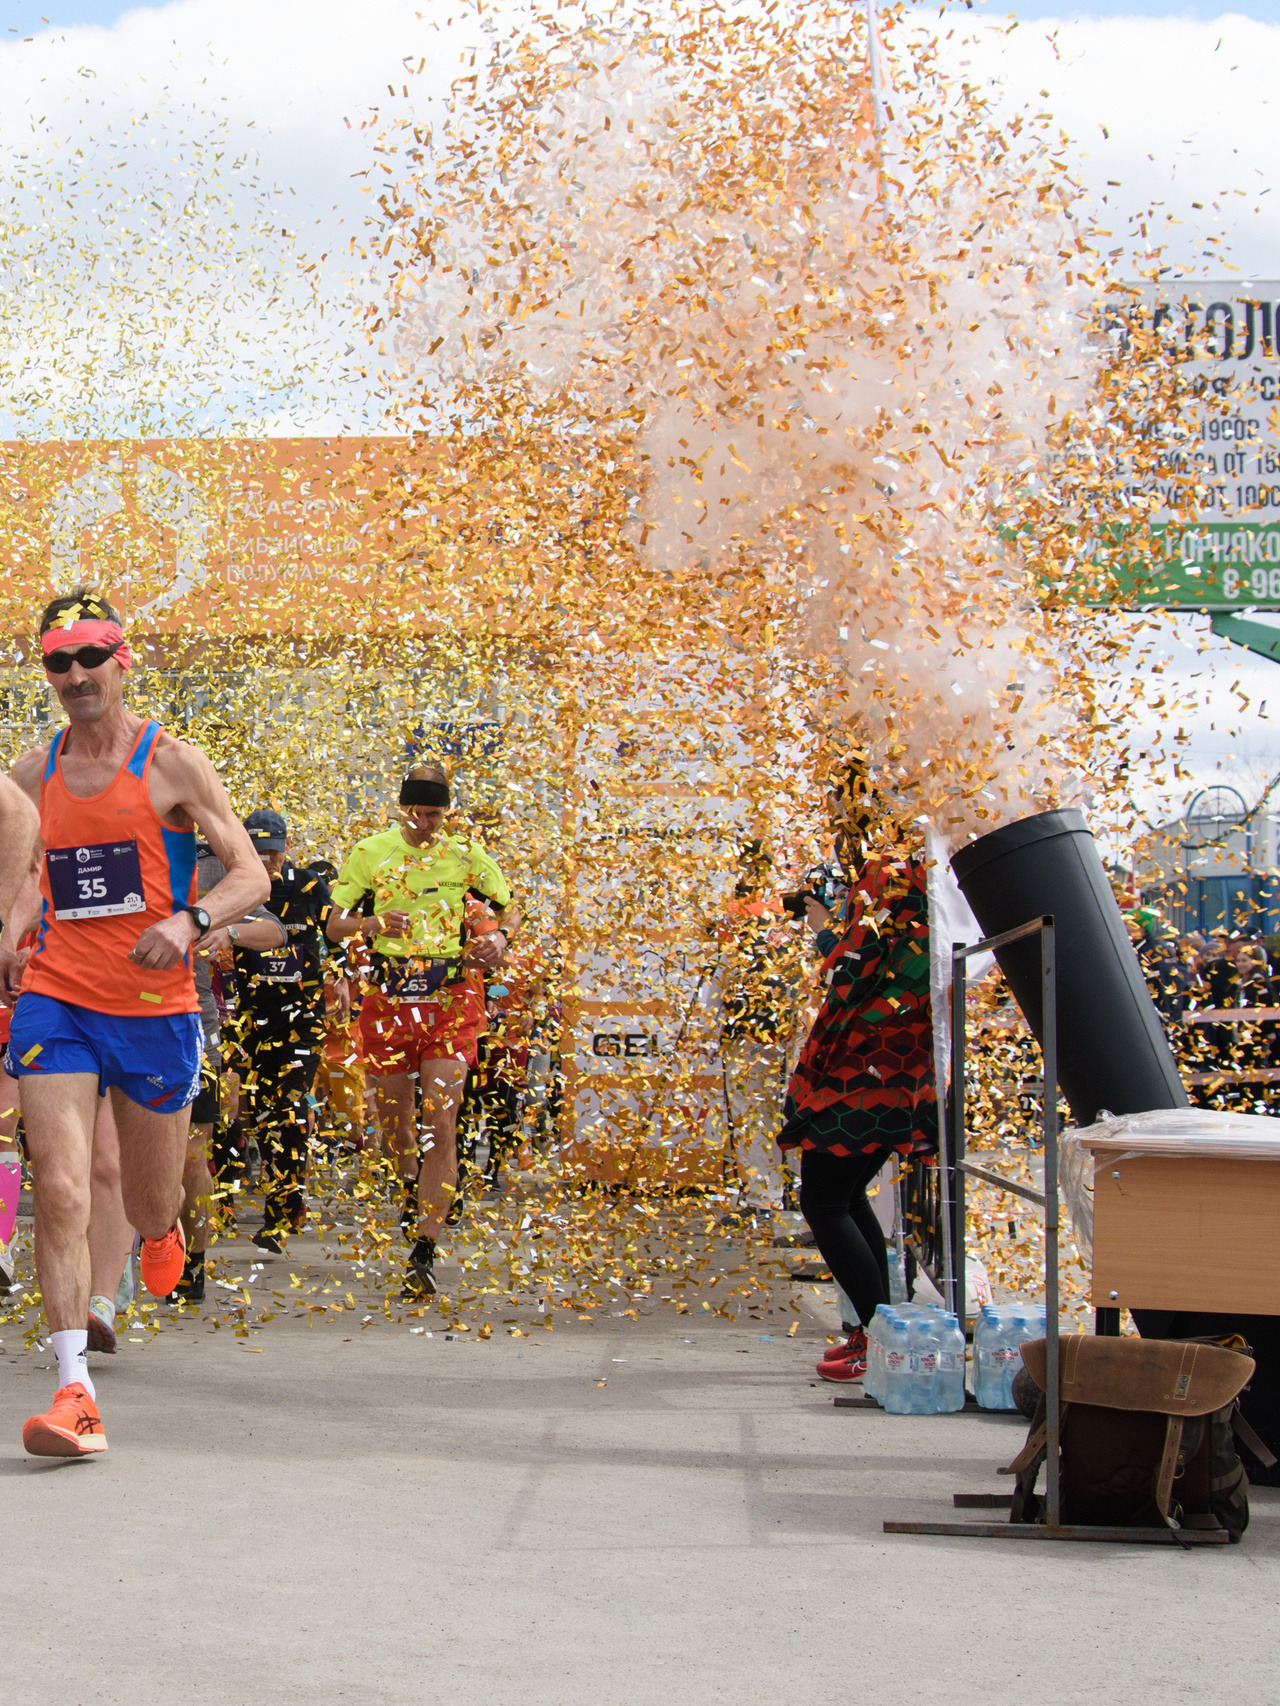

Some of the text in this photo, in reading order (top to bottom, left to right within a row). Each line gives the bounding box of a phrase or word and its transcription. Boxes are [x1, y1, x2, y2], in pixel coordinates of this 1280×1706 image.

[1224, 452, 1247, 474] ОТ
[1258, 452, 1280, 474] 15
[78, 865, 102, 875] ДАМИР
[77, 877, 108, 900] 35
[269, 961, 286, 973] 37
